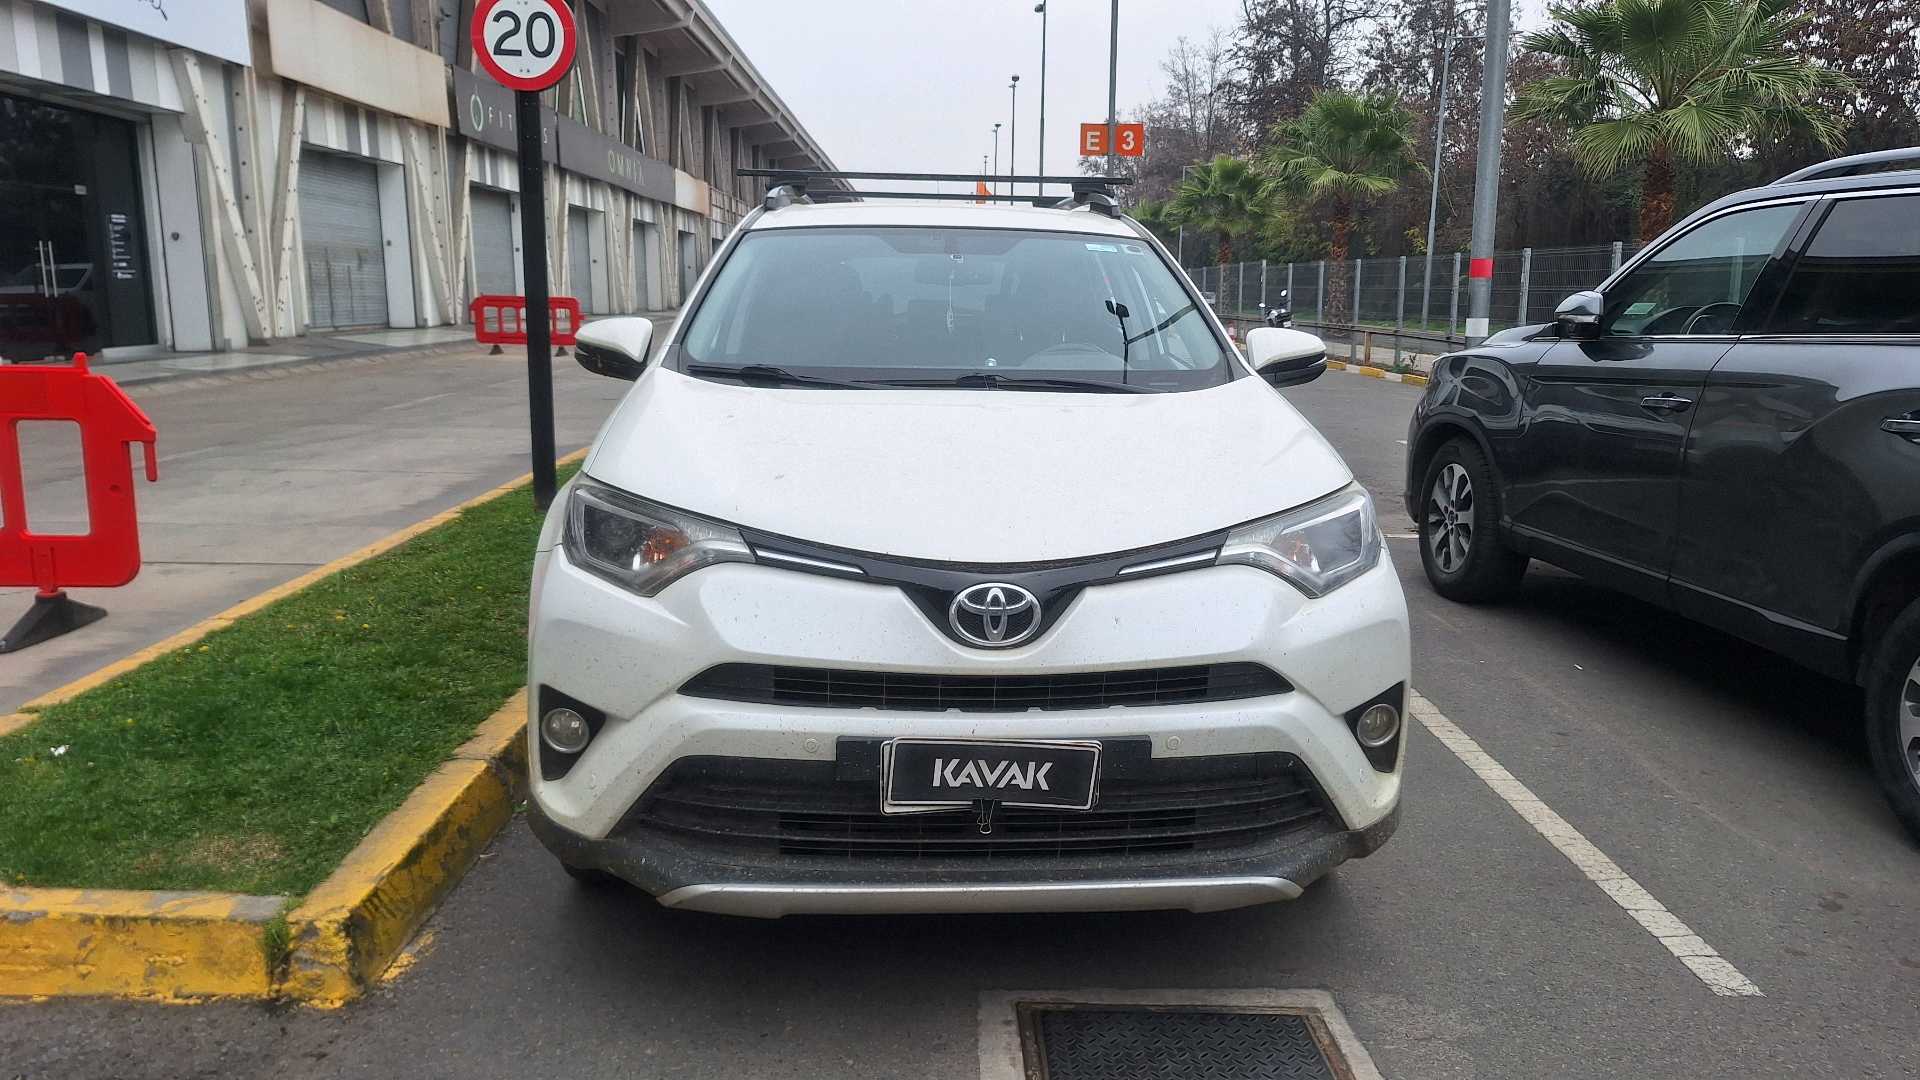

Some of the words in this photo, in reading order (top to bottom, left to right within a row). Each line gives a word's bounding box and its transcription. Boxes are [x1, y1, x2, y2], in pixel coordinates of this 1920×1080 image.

[493, 10, 556, 58] 20
[488, 105, 550, 144] FITS
[1086, 131, 1100, 151] E
[1121, 130, 1135, 151] 3
[932, 758, 1054, 791] KAVAK
